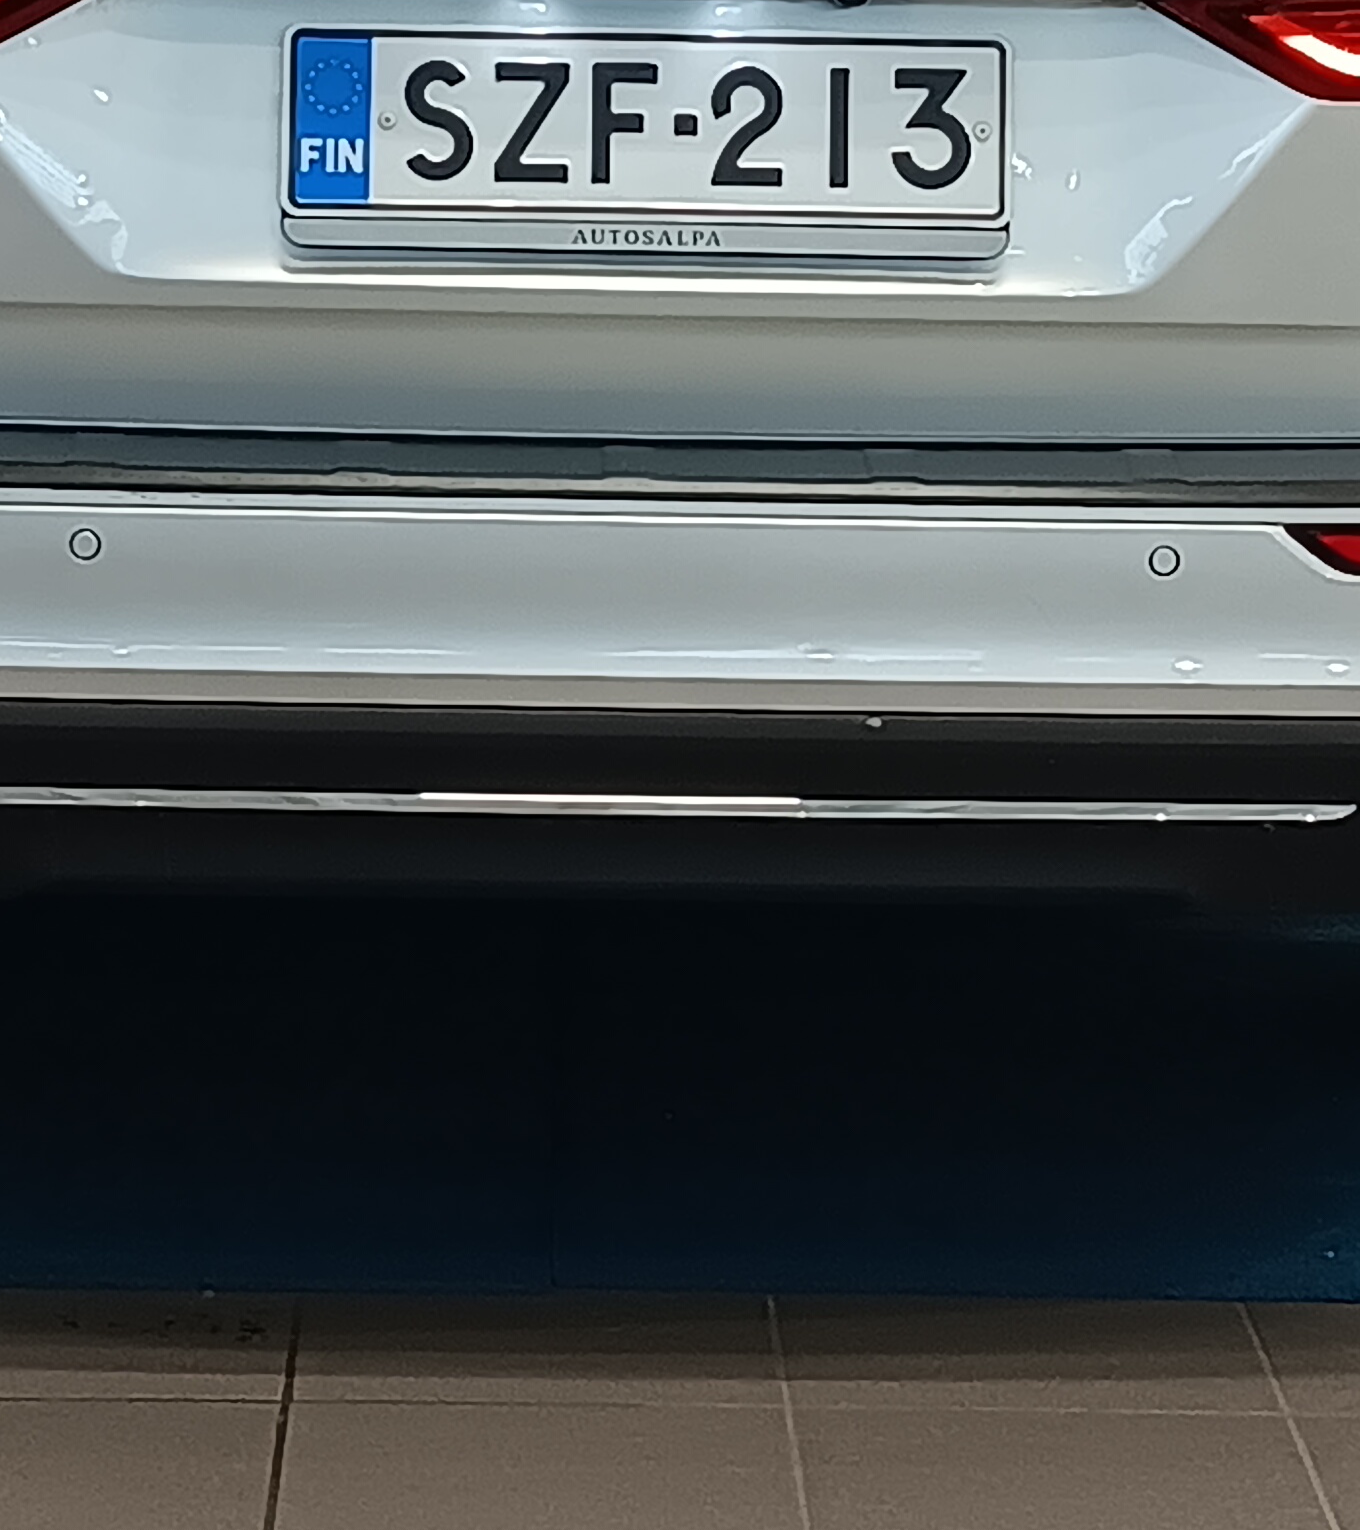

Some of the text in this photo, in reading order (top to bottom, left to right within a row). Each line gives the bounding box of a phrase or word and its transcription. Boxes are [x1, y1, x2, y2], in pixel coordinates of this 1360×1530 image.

[403, 59, 972, 190] SZF-213
[299, 137, 365, 174] FIN
[570, 227, 722, 248] AUTOSALPA
